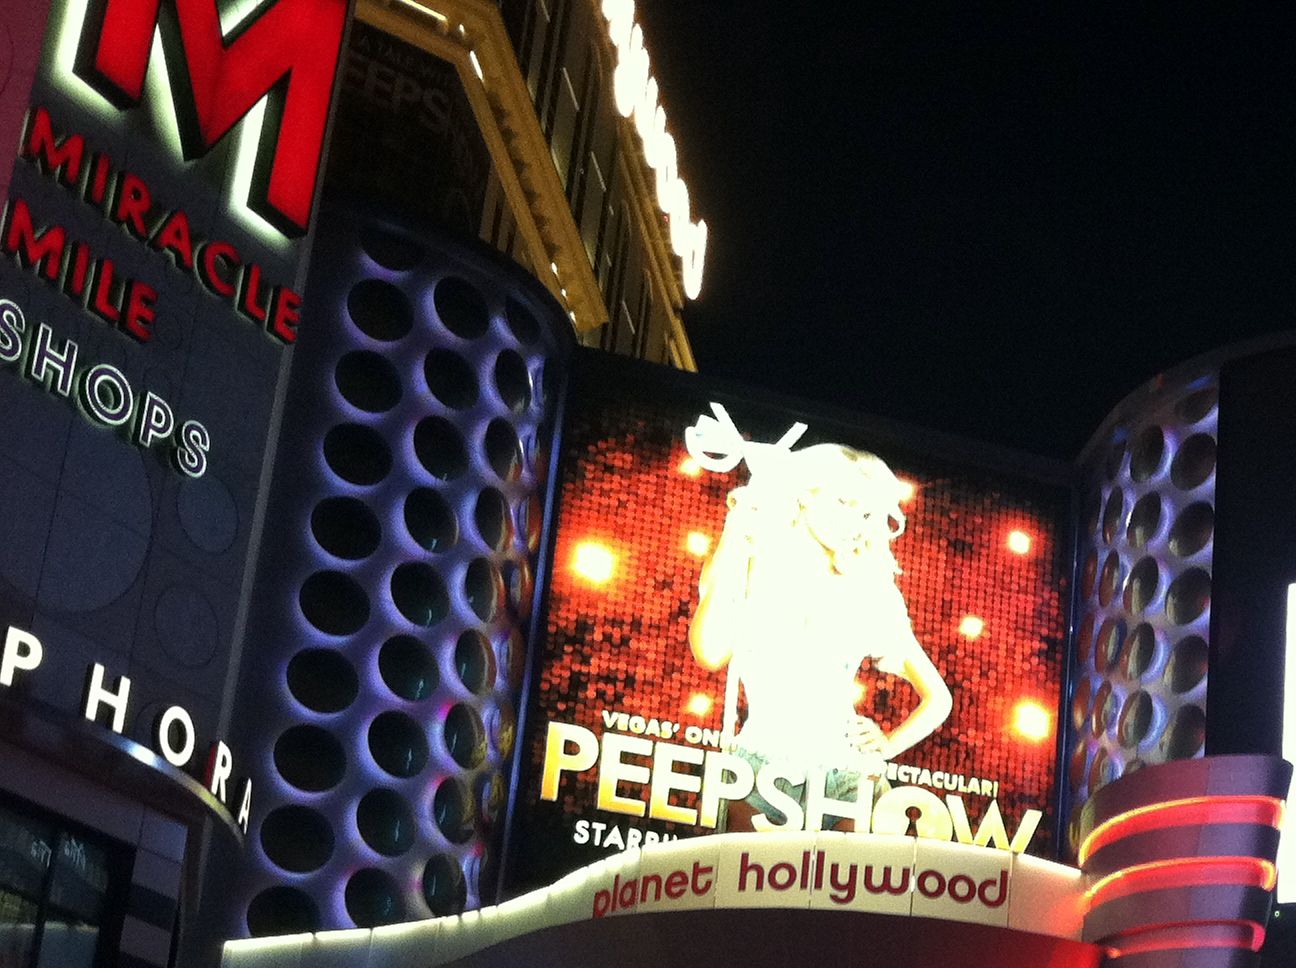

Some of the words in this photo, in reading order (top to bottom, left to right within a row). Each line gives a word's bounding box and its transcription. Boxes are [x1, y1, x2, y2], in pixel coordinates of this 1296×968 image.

[3, 198, 159, 343] MILE
[20, 107, 303, 345] MIRACLE
[0, 299, 211, 479] SHOPS
[0, 625, 252, 834] PHORA
[540, 720, 1044, 853] PEEPSHOW
[591, 860, 715, 919] planet
[737, 849, 1010, 909] hollywood
